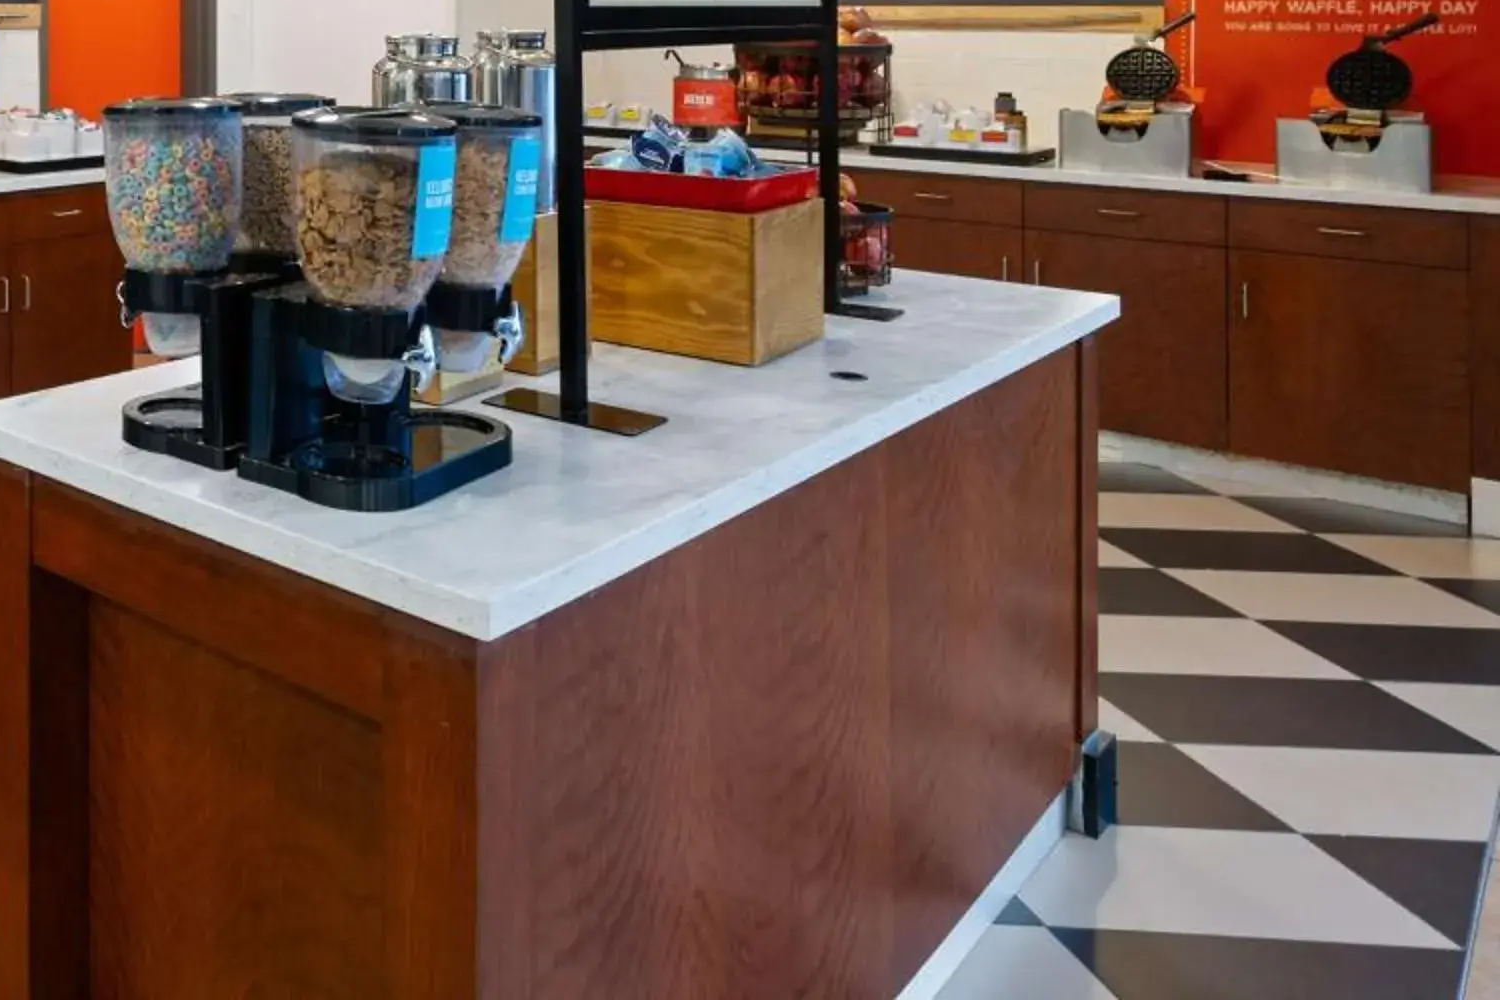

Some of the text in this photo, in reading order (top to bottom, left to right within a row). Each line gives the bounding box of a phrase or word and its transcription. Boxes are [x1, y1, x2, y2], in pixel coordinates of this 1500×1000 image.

[1224, 0, 1478, 15] HAPPY WAFFLE, HAPPY DAY
[1249, 21, 1272, 31] ARE
[1316, 22, 1331, 32] TO
[1334, 22, 1364, 33] LOVE
[1449, 23, 1477, 34] LOT!
